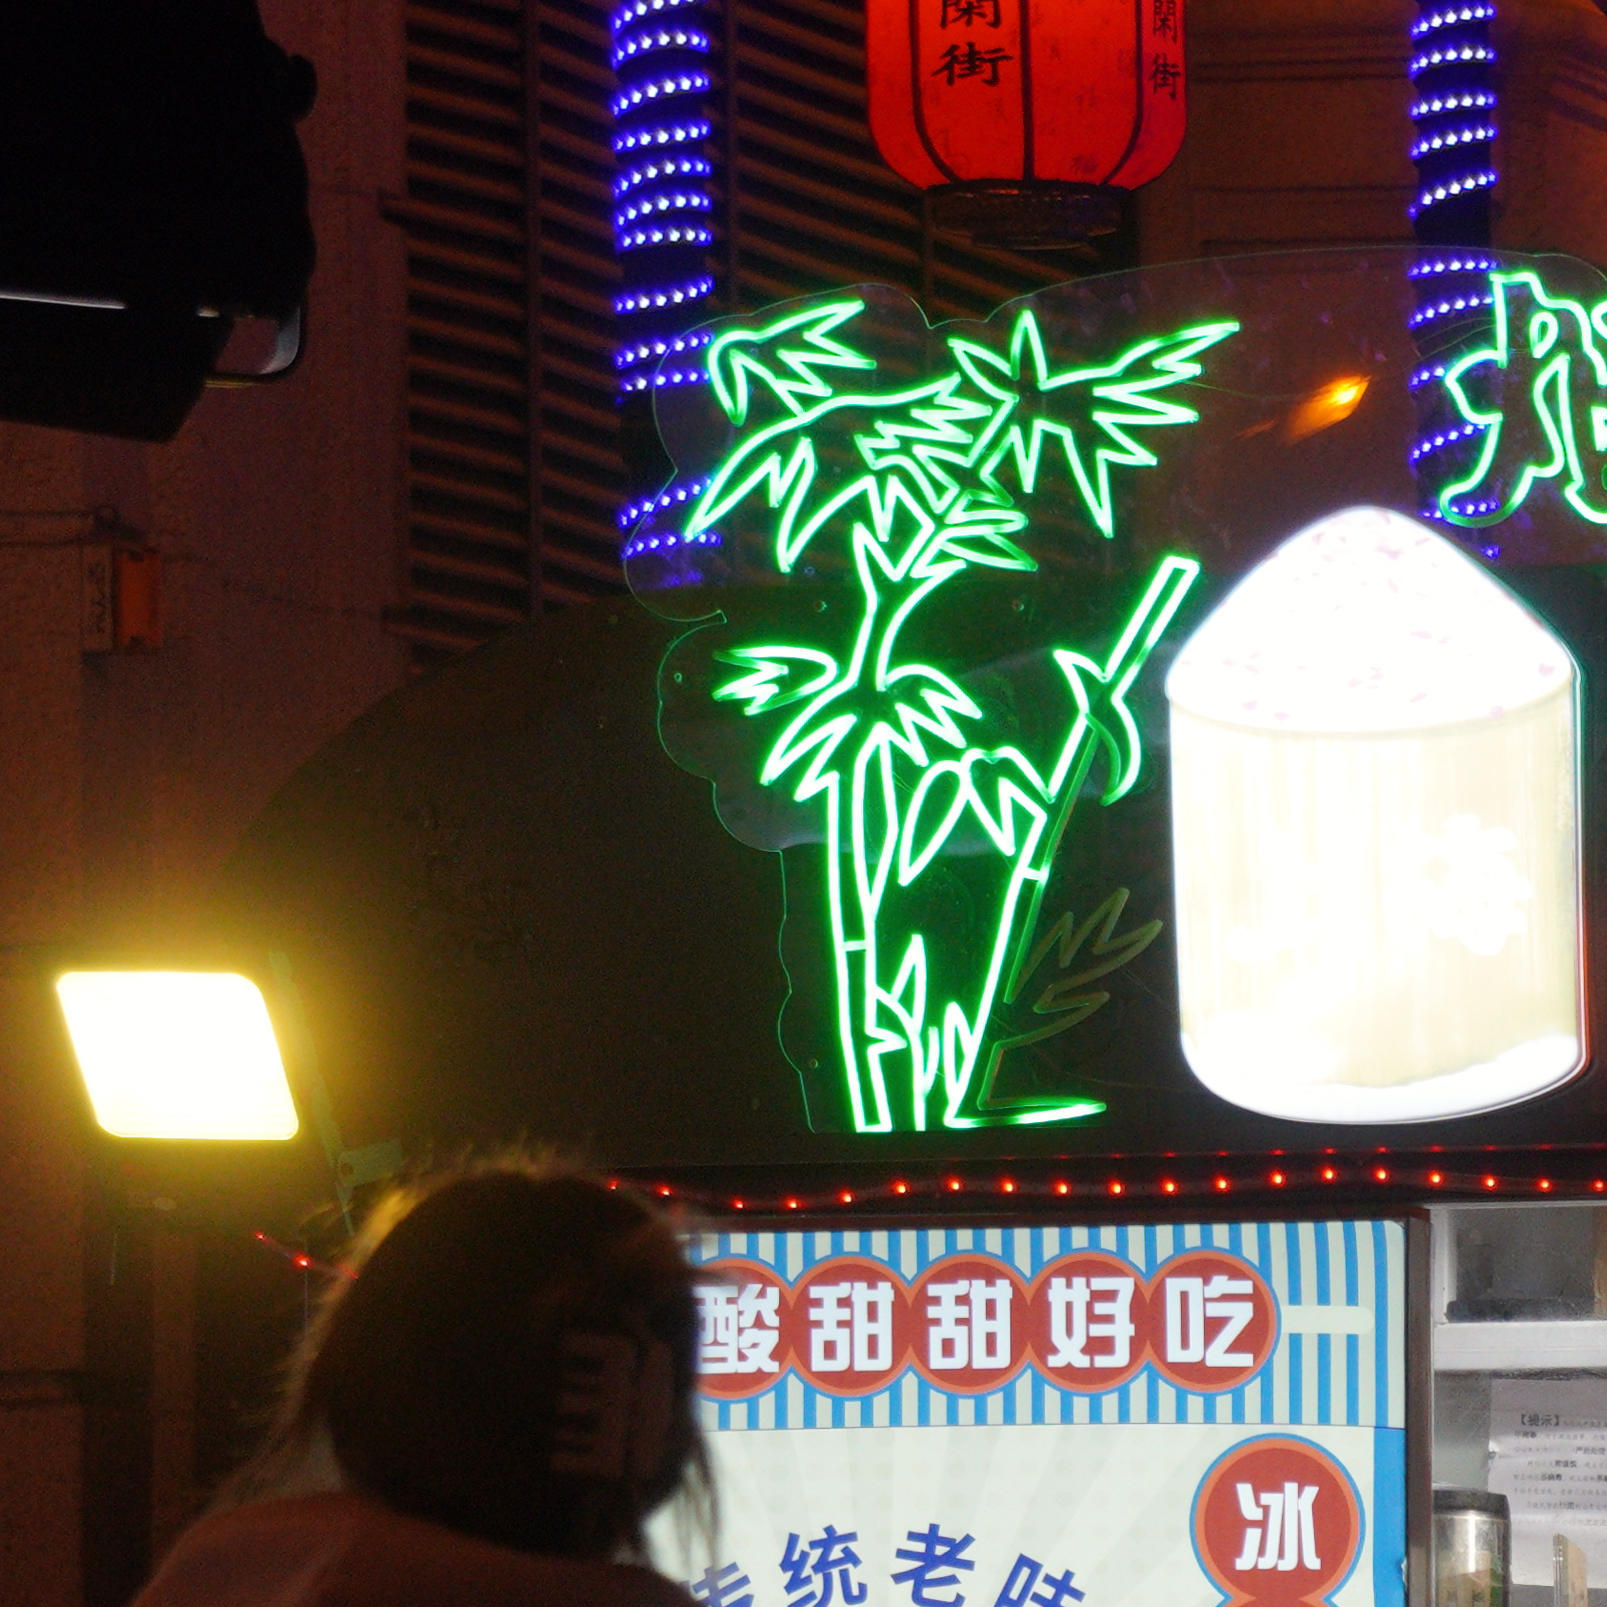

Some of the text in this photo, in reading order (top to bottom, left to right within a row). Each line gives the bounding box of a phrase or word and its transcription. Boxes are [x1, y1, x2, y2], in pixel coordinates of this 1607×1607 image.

[693, 1273, 1256, 1378] 酸甜甜好吃
